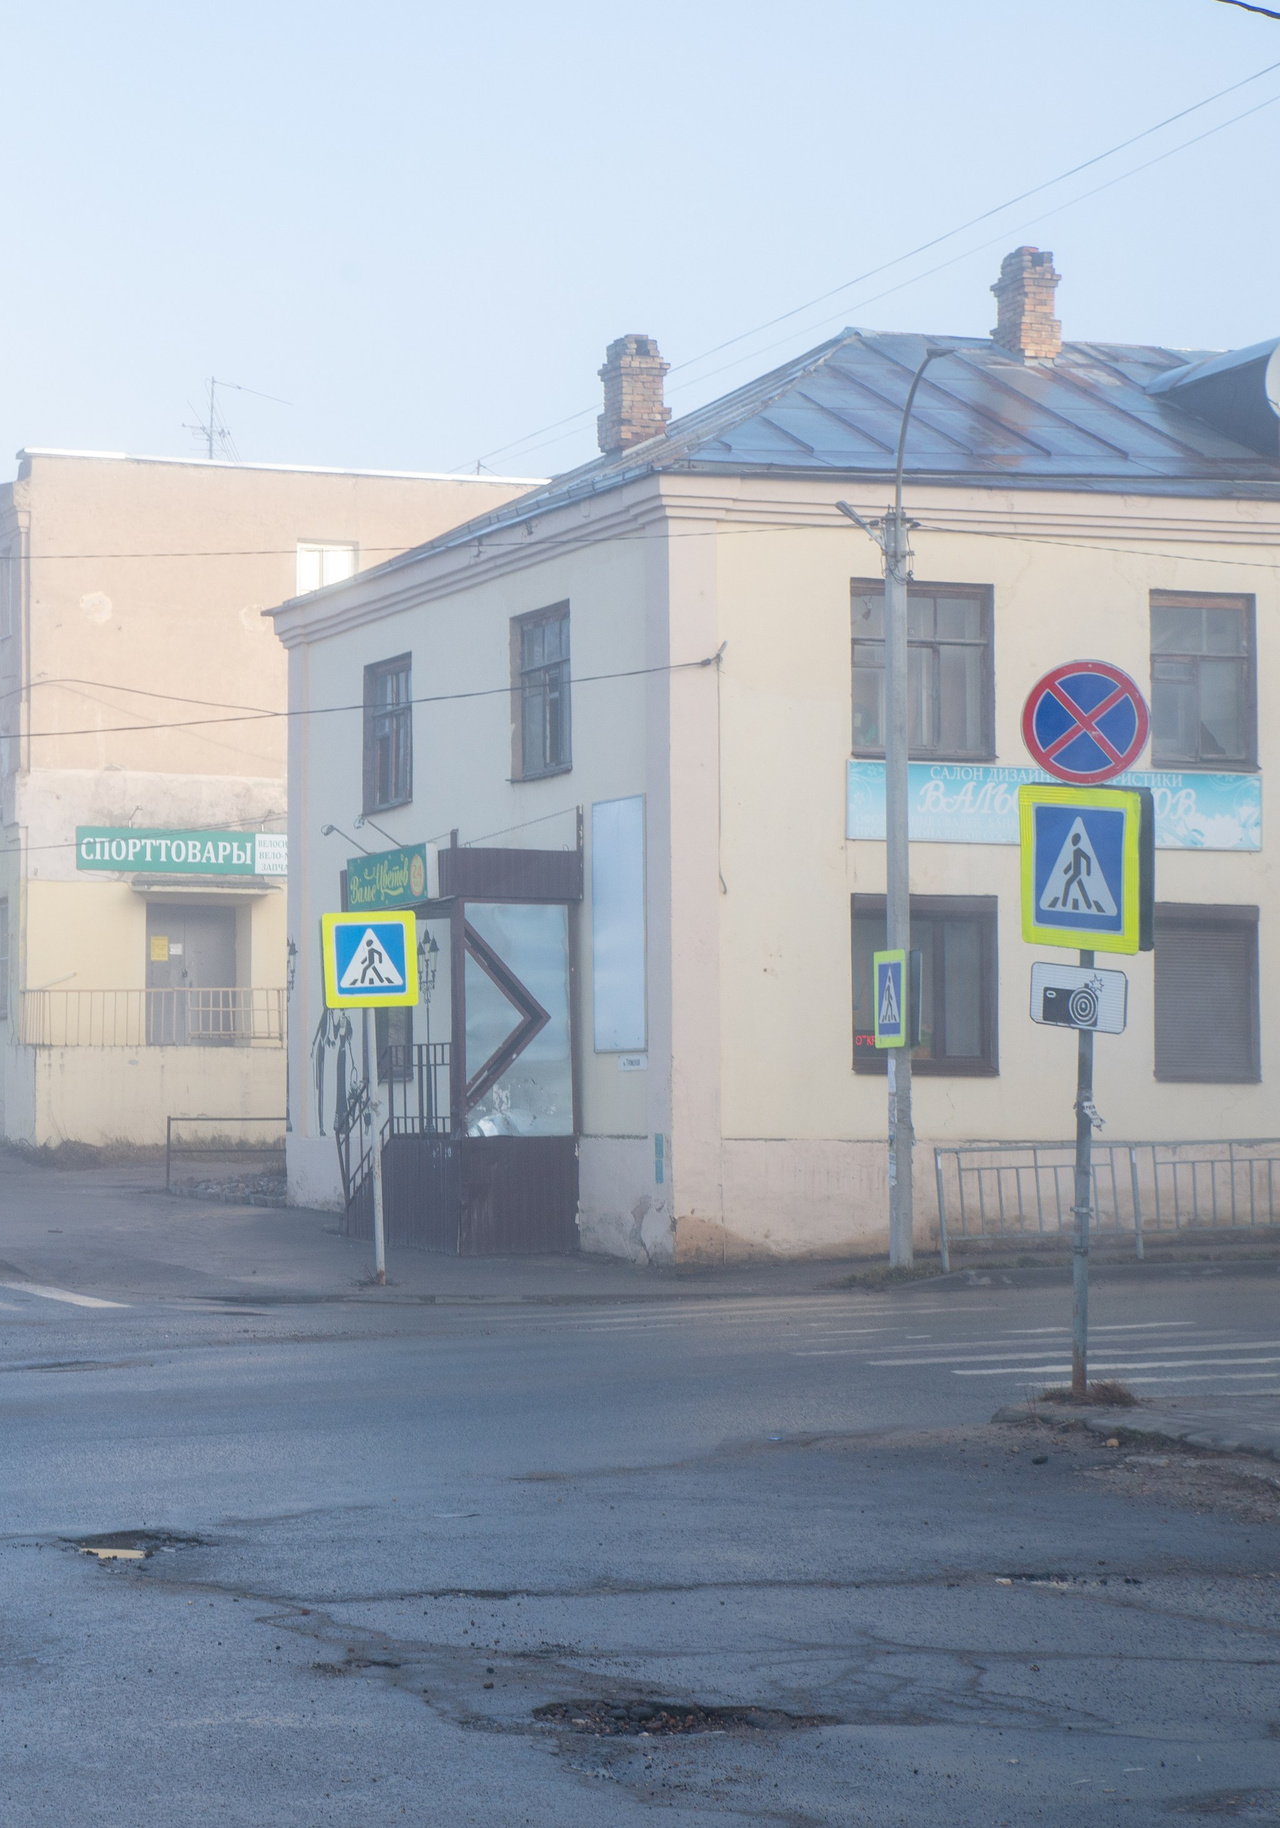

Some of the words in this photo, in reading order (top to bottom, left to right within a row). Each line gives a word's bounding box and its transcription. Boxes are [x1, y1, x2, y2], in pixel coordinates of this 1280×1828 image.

[930, 766, 983, 781] САЛОН
[988, 767, 1057, 785] ДИЗАЙН
[917, 780, 1019, 814] ВАЛЬ
[1151, 788, 1196, 820] ОВ
[80, 837, 252, 865] СПОРТТОВАРЫ
